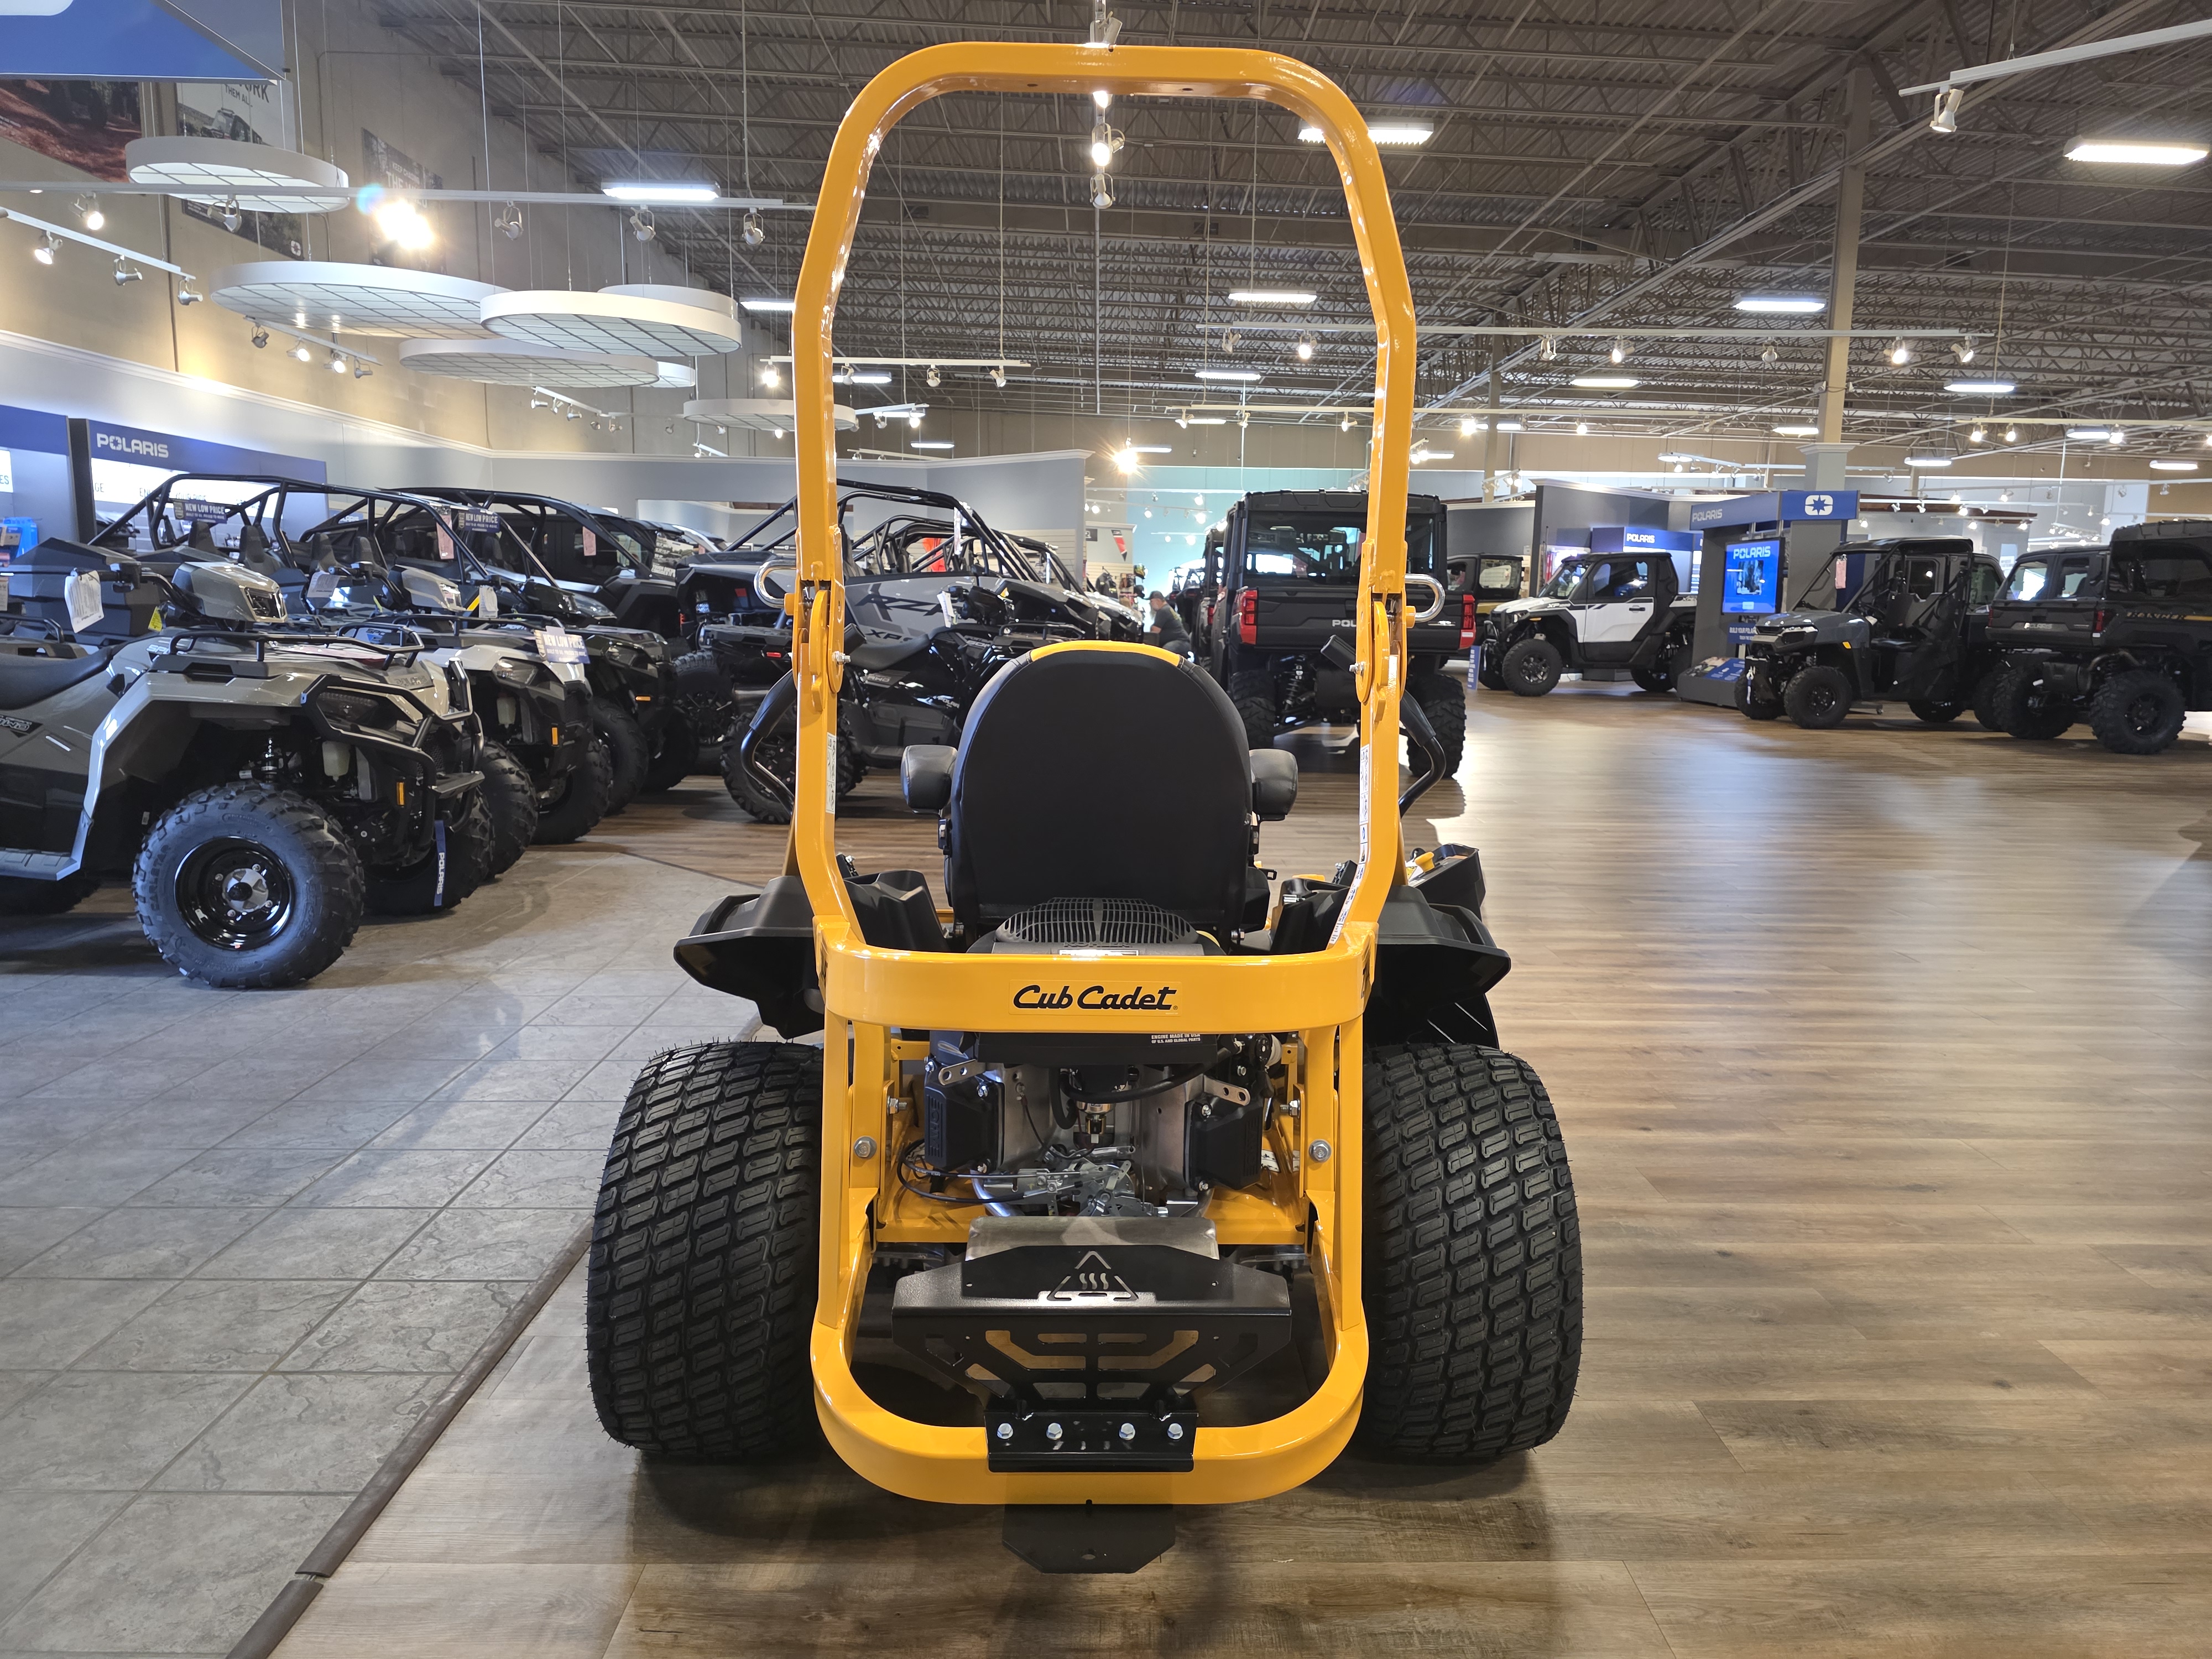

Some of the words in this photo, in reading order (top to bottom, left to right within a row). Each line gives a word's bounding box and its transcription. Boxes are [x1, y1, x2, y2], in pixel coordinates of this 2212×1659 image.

[225, 84, 241, 101] THEM
[239, 84, 269, 103] ORK
[96, 432, 169, 458] POLARIS
[0, 474, 9, 485] ES
[94, 482, 105, 493] GE
[185, 503, 197, 512] NEW
[197, 504, 208, 513] LOW
[209, 505, 225, 515] PRICE
[1692, 508, 1723, 523] POLARIS
[466, 513, 474, 521] NEW
[474, 513, 482, 522] LOW
[482, 514, 498, 524] PRICE
[1626, 533, 1655, 544] POLARIS
[1733, 546, 1771, 560] POLARIS
[543, 634, 556, 646] NEW
[556, 635, 568, 648] LOW
[568, 637, 585, 649] PRICE
[864, 629, 903, 640] XP
[937, 695, 966, 709] POLAR
[436, 852, 445, 895] POLARIS
[1013, 984, 1073, 1009] Cub
[1077, 985, 1177, 1010] Cadet
